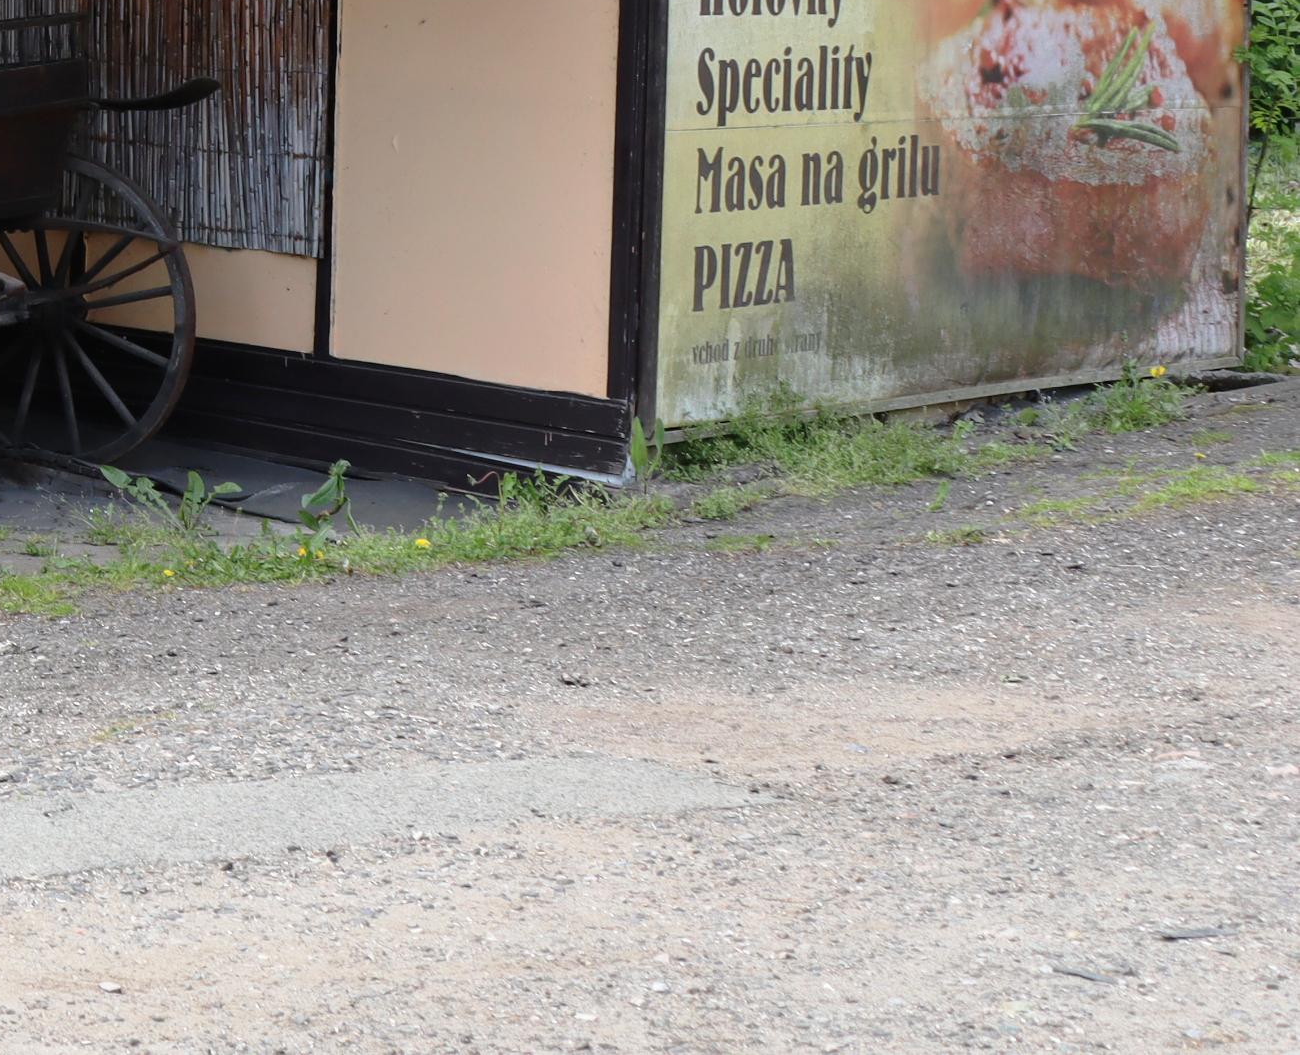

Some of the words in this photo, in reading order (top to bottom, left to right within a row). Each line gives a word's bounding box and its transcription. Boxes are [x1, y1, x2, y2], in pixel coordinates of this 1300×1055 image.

[696, 44, 872, 127] Speciality
[695, 146, 786, 214] Masa
[801, 150, 844, 206] na
[857, 134, 940, 214] grilu
[692, 238, 796, 312] PIZZA
